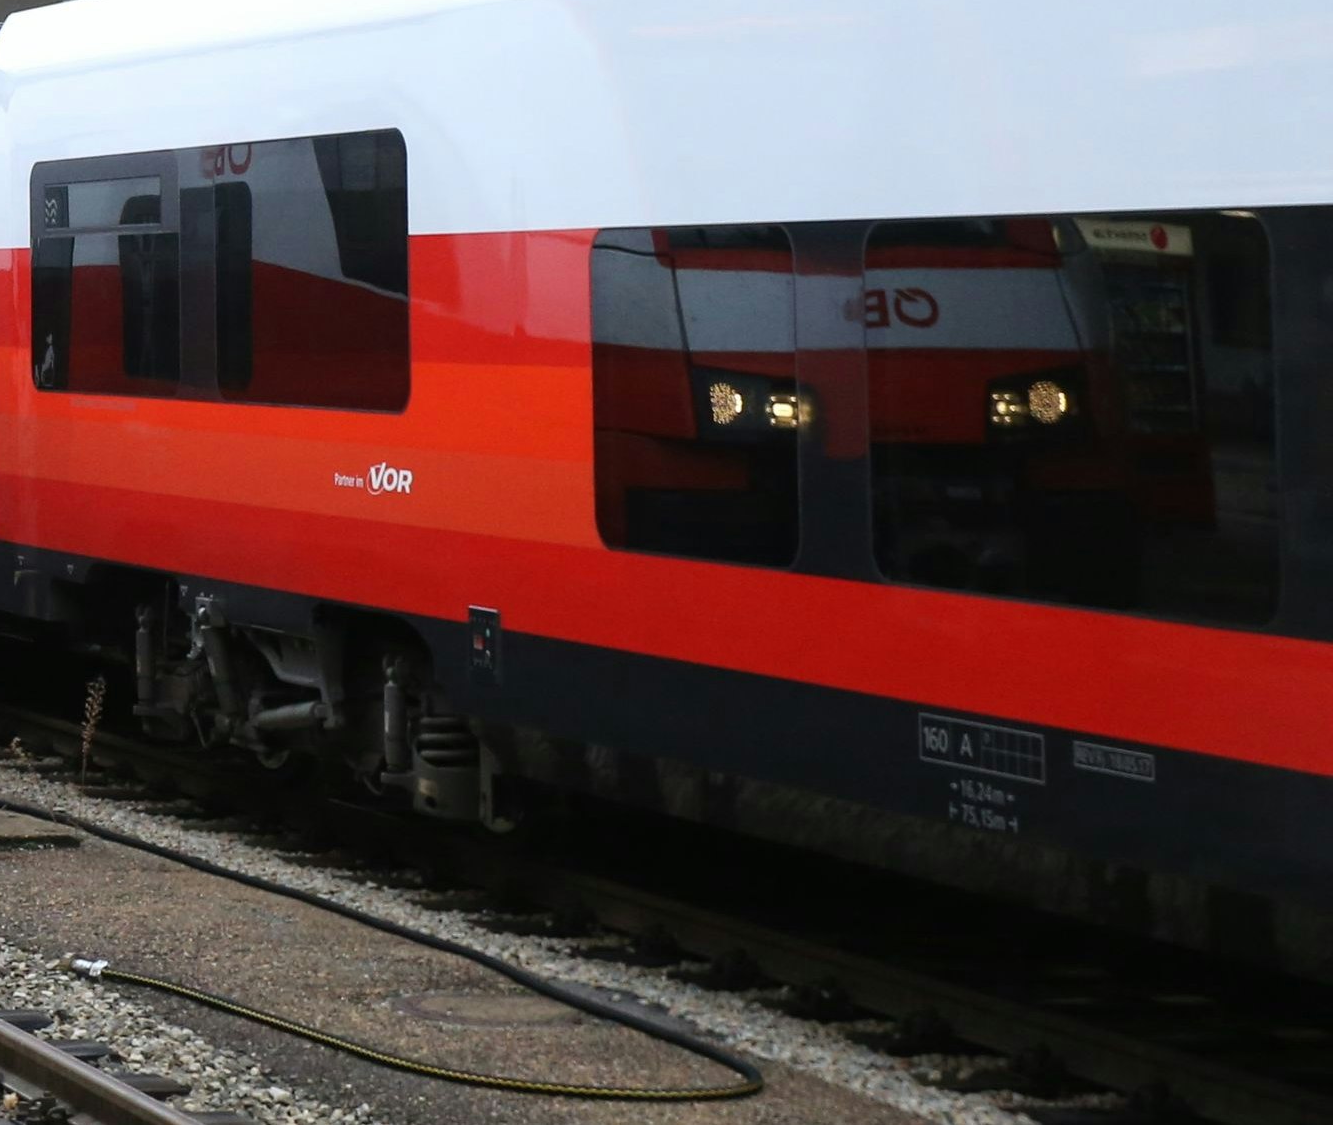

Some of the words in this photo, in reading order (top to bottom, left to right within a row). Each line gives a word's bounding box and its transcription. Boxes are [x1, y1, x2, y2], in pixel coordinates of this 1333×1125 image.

[367, 462, 413, 495] VOR
[923, 727, 949, 753] 160
[959, 733, 974, 758] A
